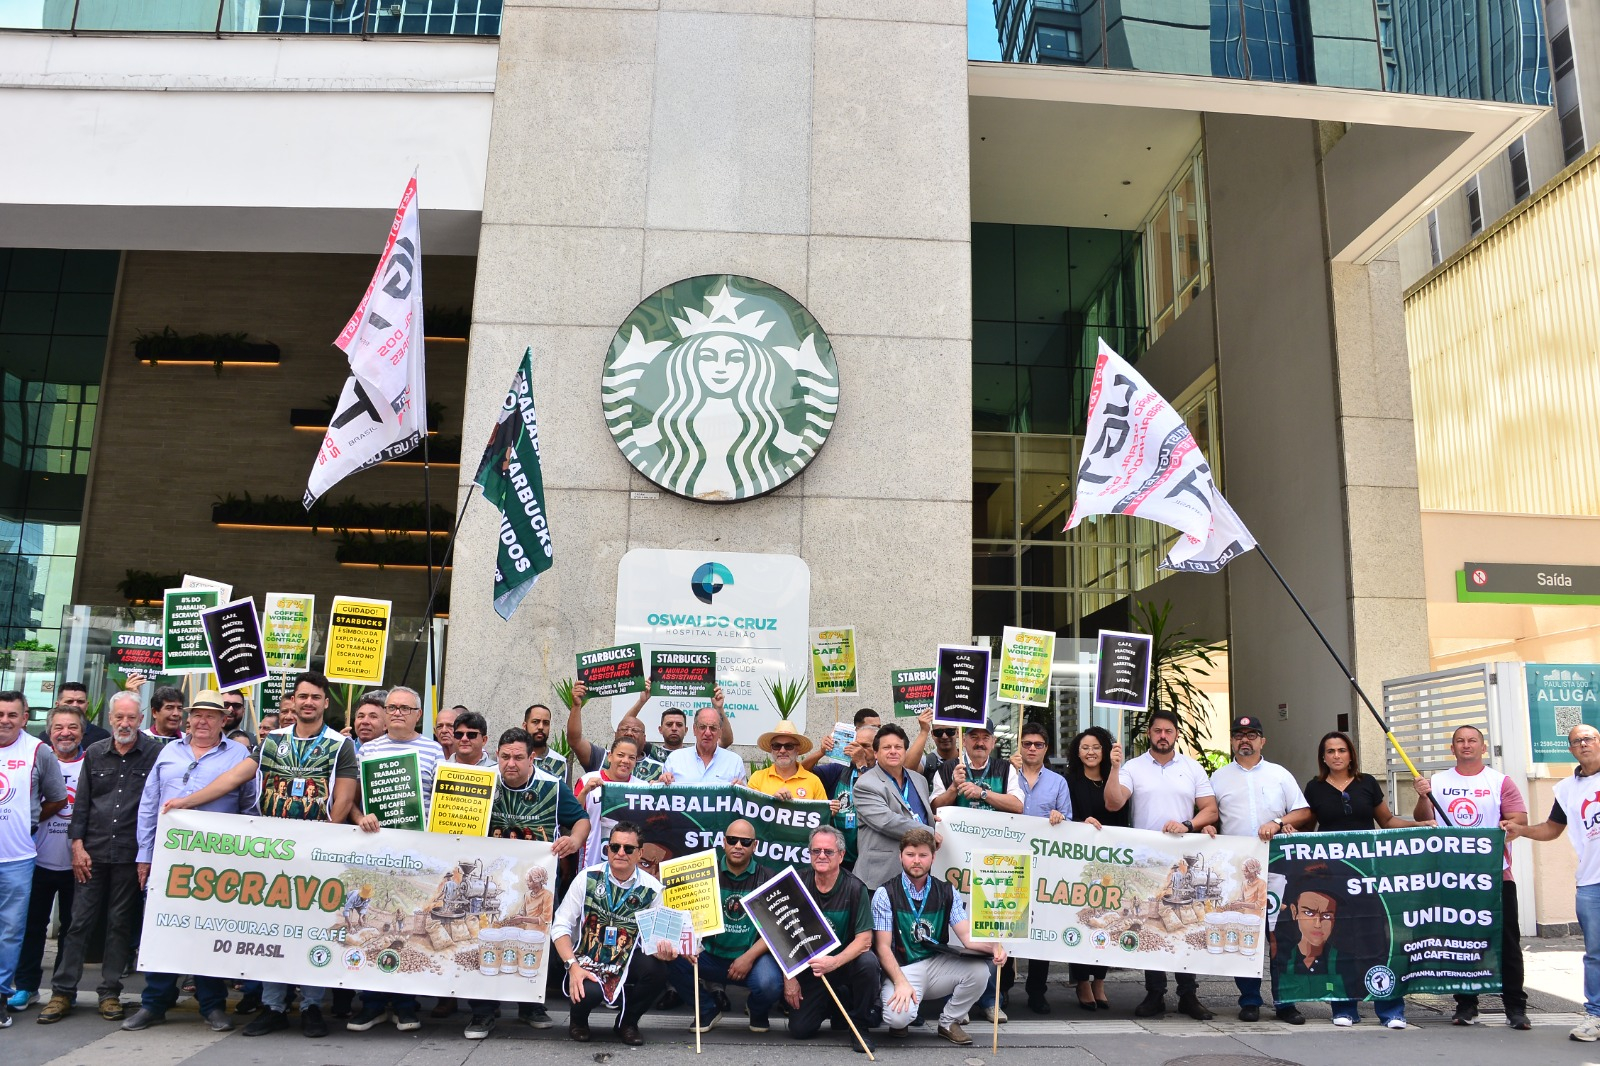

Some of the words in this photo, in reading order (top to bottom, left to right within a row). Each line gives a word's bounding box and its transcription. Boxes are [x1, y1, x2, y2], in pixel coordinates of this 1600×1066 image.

[510, 447, 552, 557] TARBUCKS
[1537, 573, 1572, 587] Saída
[277, 600, 305, 610] 67%
[343, 606, 378, 615] CUIDADO!
[336, 616, 383, 627] STARBUCKS
[647, 614, 730, 628] OSWALDO
[734, 618, 777, 630] CRUZ
[342, 628, 368, 636] SÍMBOLO
[717, 630, 756, 638] ALEMÃO
[335, 635, 374, 644] EXPLORAÇÃO
[346, 644, 376, 652] TRABALHO
[813, 646, 842, 655] CAFÉ
[1007, 648, 1049, 658] WORKERS
[1013, 644, 1044, 652] COFFEE
[582, 648, 636, 665] STARBUCKS:
[657, 654, 710, 664] STARBUCKS:
[721, 656, 764, 664] EDUCAÇÃO
[591, 665, 615, 674] MUNDO
[730, 664, 756, 672] SAÚDE
[1004, 669, 1045, 678] CONTRACT
[618, 680, 634, 688] Acordo
[817, 679, 854, 688] EXPLORAÇÃO
[952, 676, 975, 684] MARKETING
[727, 688, 752, 696] SAÚDE
[908, 685, 932, 693] MUNDO
[1001, 683, 1047, 696] EXPLOITATION!
[1537, 689, 1596, 701] ALUGA
[379, 762, 389, 770] 8%
[373, 768, 406, 778] TRABALHO
[447, 772, 484, 783] CUIDADO!
[370, 777, 400, 787] ESCRAVO
[372, 786, 394, 795] BRASIL
[395, 782, 410, 791] ESTÁ
[440, 784, 488, 795] STARBUCKS
[1442, 788, 1490, 797] UGT-SP
[369, 796, 382, 804] NAS
[382, 791, 416, 802] FAZENDAS
[446, 796, 472, 804] SÍMBOLO
[438, 803, 477, 813] EXPLORAÇÃO
[624, 793, 821, 829] TRABALHADORES
[448, 812, 480, 821] TRABALHO
[438, 820, 466, 828] ESCRAVO
[949, 822, 979, 834] when
[981, 827, 1002, 839] you
[1003, 830, 1025, 842] buy
[164, 828, 296, 861] STARBUCKS
[685, 831, 811, 864] STAUCKS
[1280, 836, 1492, 861] TRABALHADORES
[1030, 838, 1134, 866] STARBUCKS
[311, 848, 364, 865] financia
[365, 854, 423, 871] trabalho
[983, 855, 1017, 866] 67%
[670, 861, 705, 874] CUIDADO!
[666, 870, 711, 886] STARBUCKS
[973, 876, 1014, 886] CAFÉ
[1346, 871, 1493, 895] STARBUCKS
[165, 862, 346, 912] ESCRAVO
[669, 890, 706, 902] EXPLORAÇÃO
[1036, 877, 1122, 910] LABOR
[681, 895, 710, 907] TRABALHO
[984, 899, 1017, 909] NÃO
[776, 908, 799, 926] MARKETING
[1402, 906, 1493, 928] UNIDOS
[156, 913, 190, 928] NAS
[195, 917, 279, 937] LAVOURAS
[283, 925, 303, 939] DE
[308, 926, 347, 942] CAFÉ
[784, 917, 800, 930] GLOBAL
[791, 927, 804, 938] LABOR
[213, 939, 232, 953] DO
[236, 942, 284, 958] BRASIL
[1403, 938, 1442, 953] CONTRA
[1443, 938, 1488, 949] ABUSOS
[1410, 953, 1423, 963] NA
[1424, 950, 1481, 962] CAFETERIA
[1401, 971, 1435, 982] CAMPANHA
[1436, 969, 1492, 978] INTERNACIONAL
